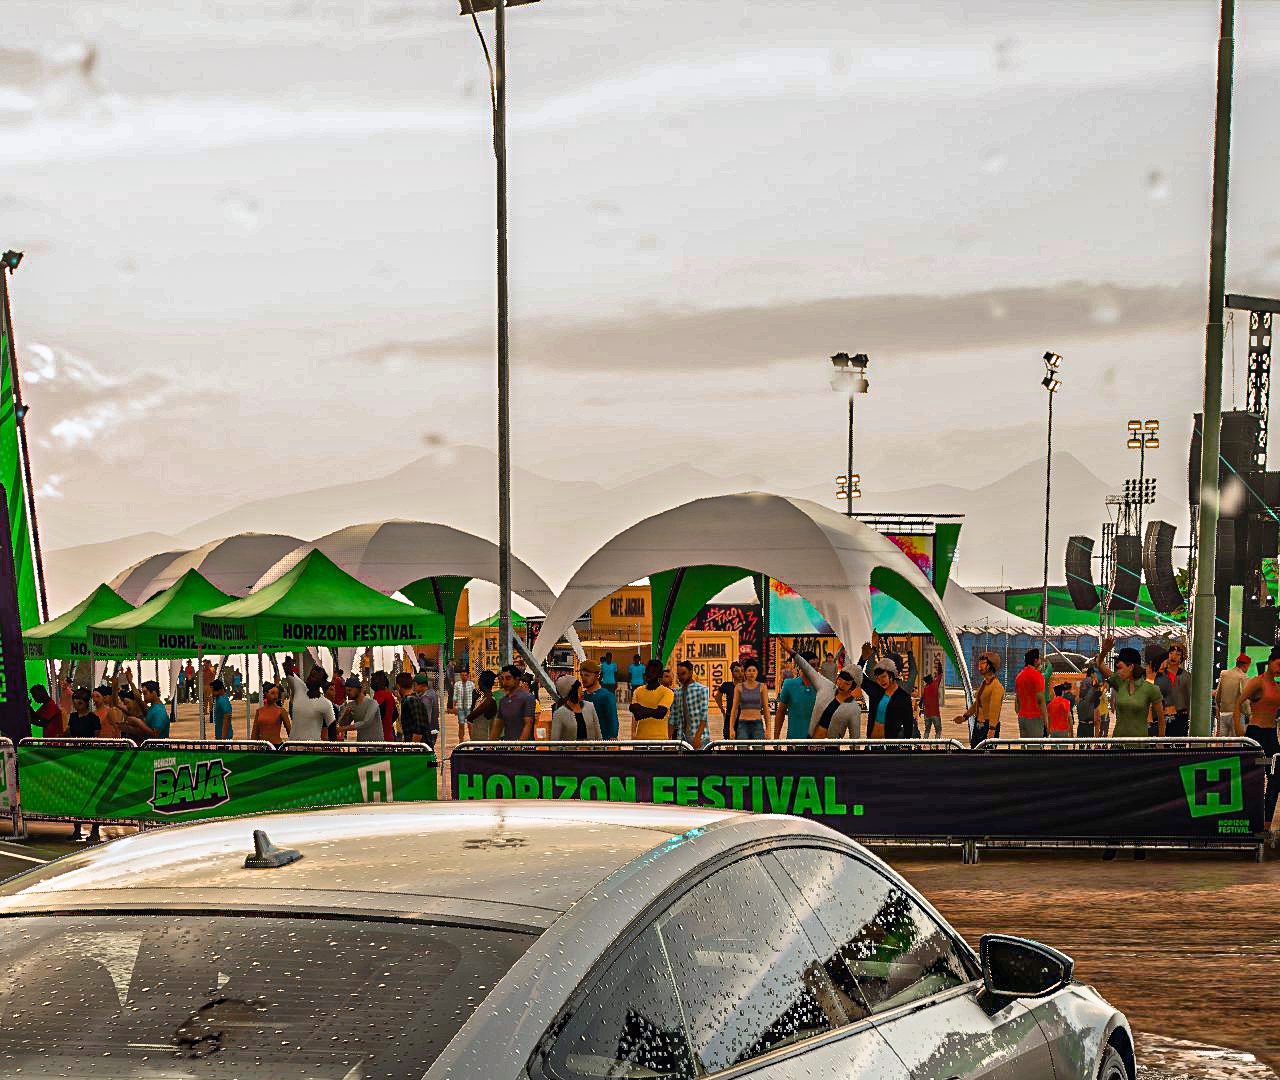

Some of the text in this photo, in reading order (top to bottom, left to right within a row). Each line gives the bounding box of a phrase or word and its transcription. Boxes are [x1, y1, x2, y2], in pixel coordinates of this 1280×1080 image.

[283, 623, 423, 640] HORIZON FESTIVAL.
[155, 762, 227, 806] BAJA
[652, 776, 865, 816] FESTIVAL.
[1195, 768, 1232, 806] H
